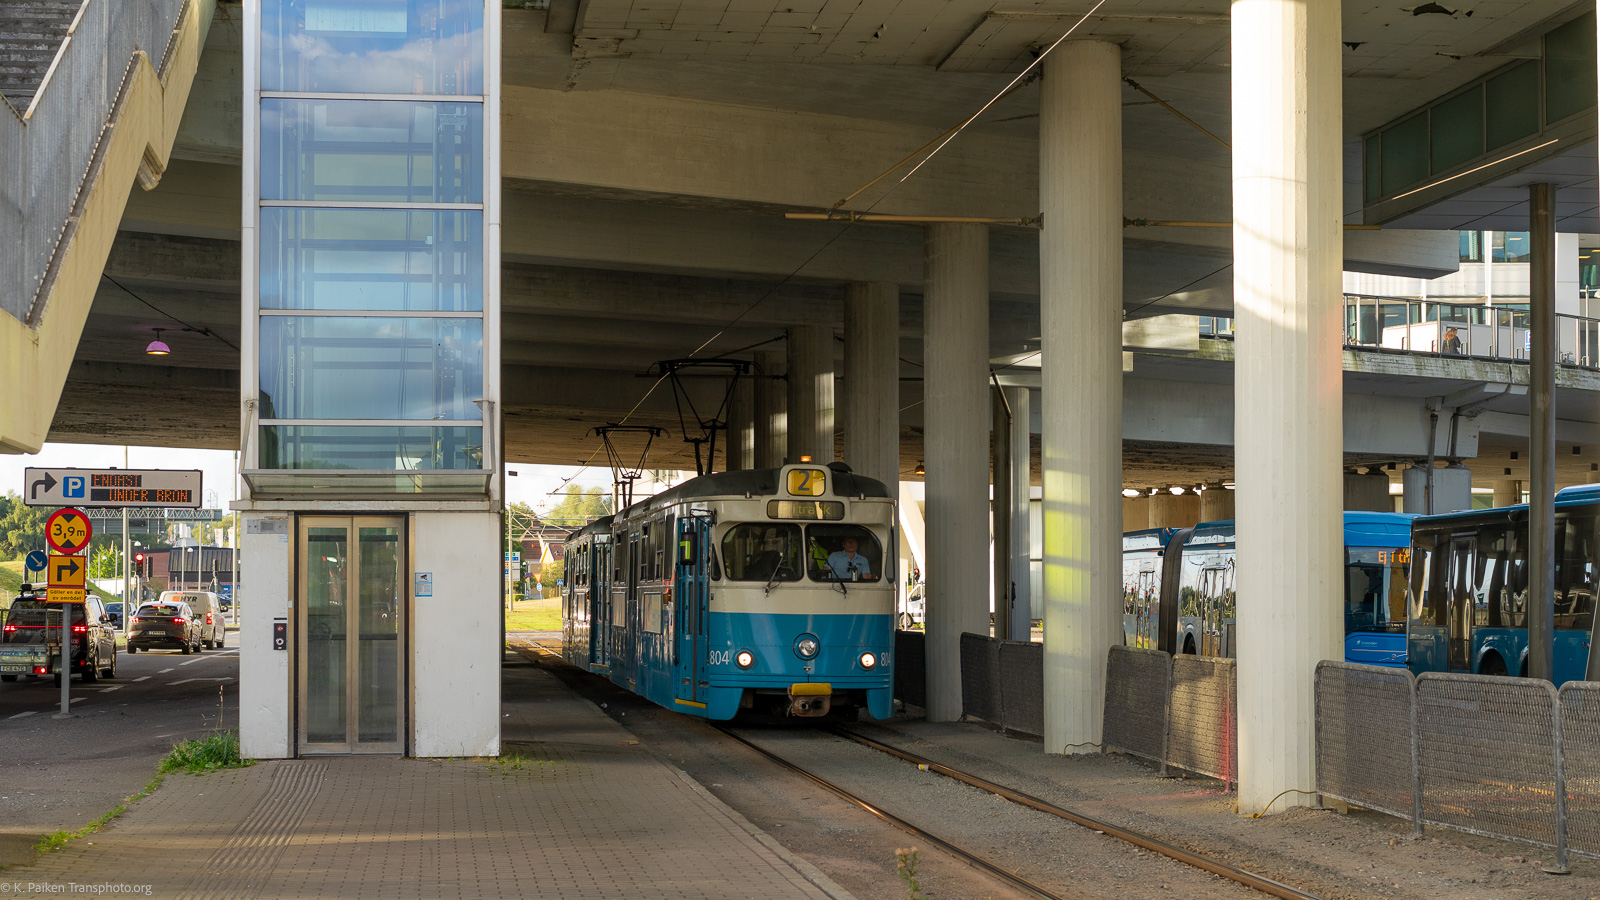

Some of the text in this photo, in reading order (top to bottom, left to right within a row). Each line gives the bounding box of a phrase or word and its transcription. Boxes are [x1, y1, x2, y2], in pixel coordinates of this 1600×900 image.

[68, 477, 82, 496] P
[93, 474, 139, 487] ENDAST
[797, 470, 810, 491] 2
[109, 488, 188, 503] UNDER BRON
[1378, 551, 1387, 565] Ej
[710, 650, 730, 665] 804
